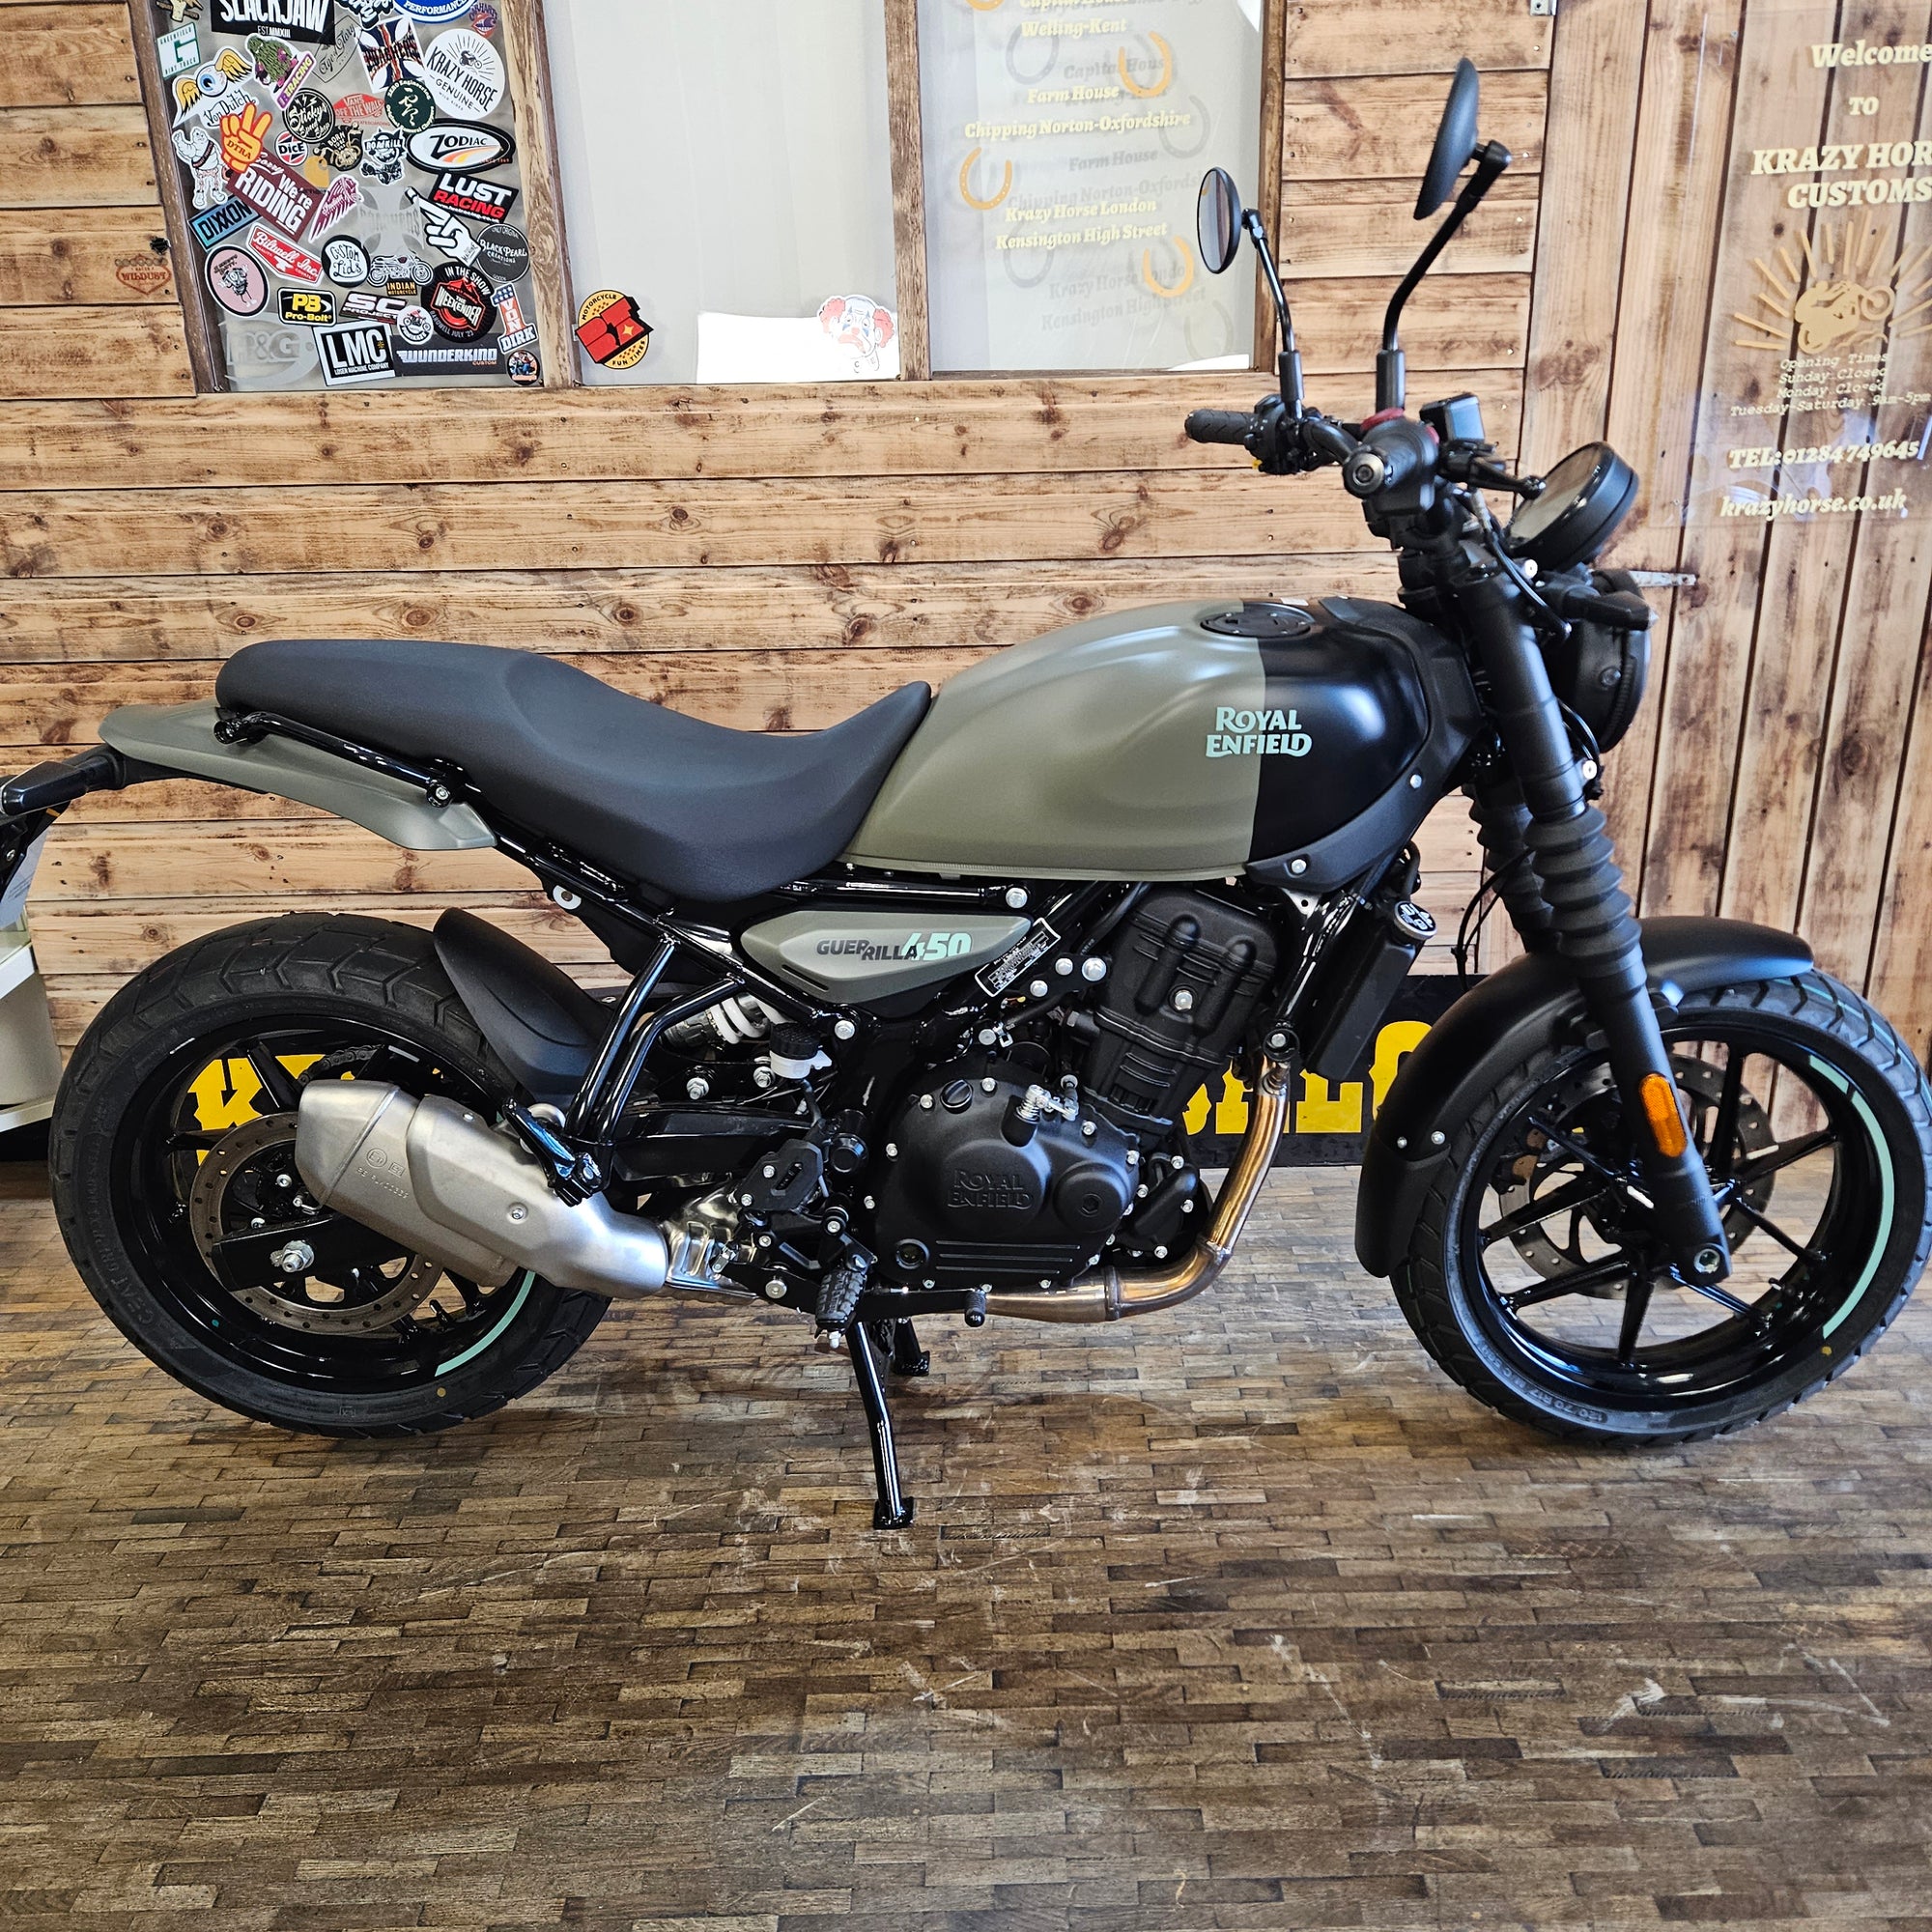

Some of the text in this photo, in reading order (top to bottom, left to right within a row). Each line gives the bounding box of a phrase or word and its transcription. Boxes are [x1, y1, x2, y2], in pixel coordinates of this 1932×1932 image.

[220, 0, 328, 33] SLACKJAW
[1021, 18, 1126, 40] Welling-Kent
[1811, 39, 1932, 68] Welcome
[426, 45, 498, 112] KRAZY HORSE
[219, 89, 251, 117] Dutch
[344, 96, 364, 106] VANS
[435, 78, 474, 110] GENUINE
[1027, 88, 1071, 104] Farm
[1071, 84, 1120, 100] House
[1849, 97, 1879, 116] TO
[348, 102, 365, 117] THE
[364, 99, 384, 114] WALL
[327, 131, 346, 147] BORN
[965, 109, 1191, 142] Chipping Norton-Oxfordshire
[227, 140, 251, 159] DTRA
[430, 134, 488, 159] ZODIAC
[1750, 140, 1932, 175] KRAZY HOR
[235, 168, 306, 233] RIDING
[279, 174, 313, 211] We're
[439, 173, 512, 206] LUST
[1788, 176, 1932, 209] CUSTOMS
[433, 189, 505, 218] RACING
[1005, 196, 1156, 223] Krazy Horse London
[197, 200, 253, 241] DIXXON
[995, 222, 1167, 250] Kensington High Street
[387, 281, 415, 291] INDIAN
[444, 266, 491, 296] IN THE SHOW
[292, 294, 321, 312] PB
[435, 286, 482, 327] WEEKENDER
[503, 298, 523, 332] VON
[582, 294, 617, 321] MOTORCYCLE
[326, 328, 387, 368] LMC
[502, 325, 537, 351] DIRK
[630, 340, 645, 362] TIMES
[396, 348, 497, 363] WUNDERKIND
[1780, 353, 1887, 372] Opening Times
[1845, 440, 1919, 464] 749645
[1719, 488, 1907, 521] krazyhorse.co.uk
[1215, 706, 1302, 733] ROYAL
[1206, 733, 1313, 757] ENFIELD
[816, 932, 972, 961] GUERRILLA 450
[952, 1169, 1024, 1191] ROYAL
[948, 1191, 1033, 1209] ENFIELD
